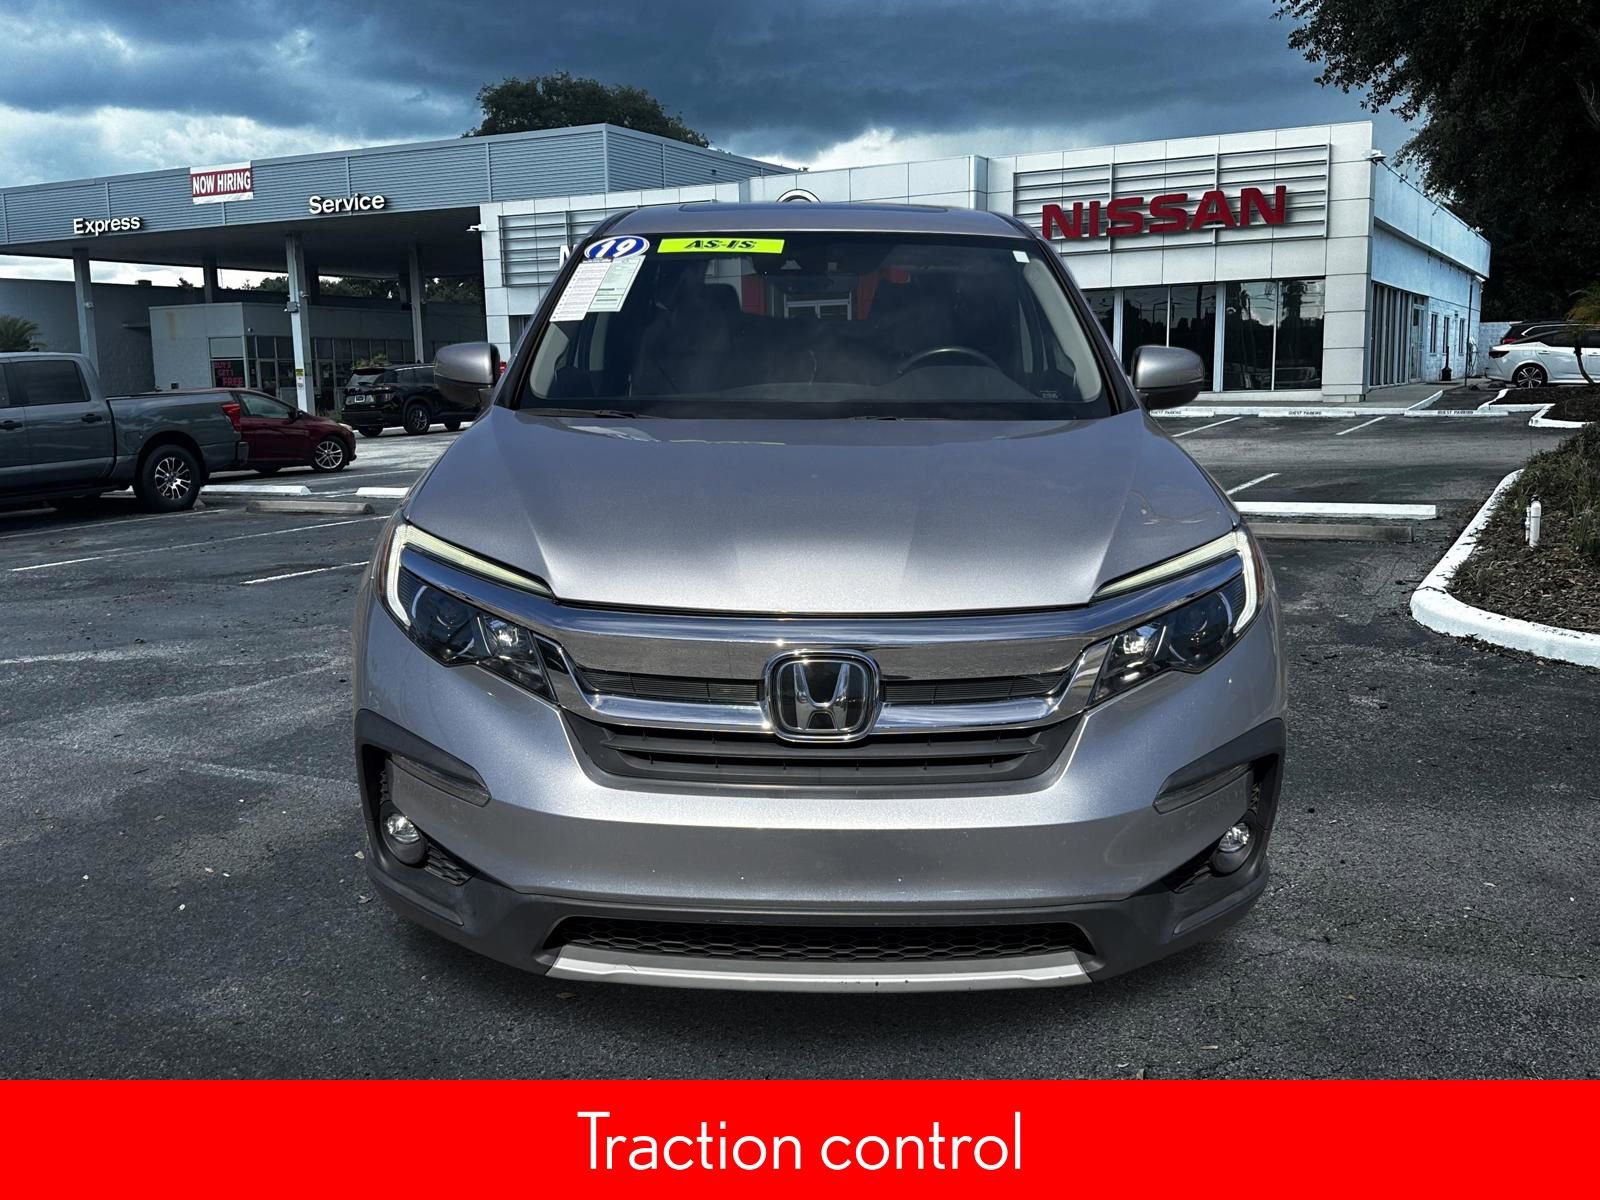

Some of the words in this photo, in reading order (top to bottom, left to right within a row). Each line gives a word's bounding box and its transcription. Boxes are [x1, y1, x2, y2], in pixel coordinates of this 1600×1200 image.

[192, 174, 215, 195] NOW
[217, 171, 251, 192] HIRING
[309, 192, 385, 215] Service
[1042, 185, 1287, 240] NISSAN
[73, 216, 141, 236] Express
[595, 239, 637, 258] 19
[684, 239, 757, 250] AS-IS
